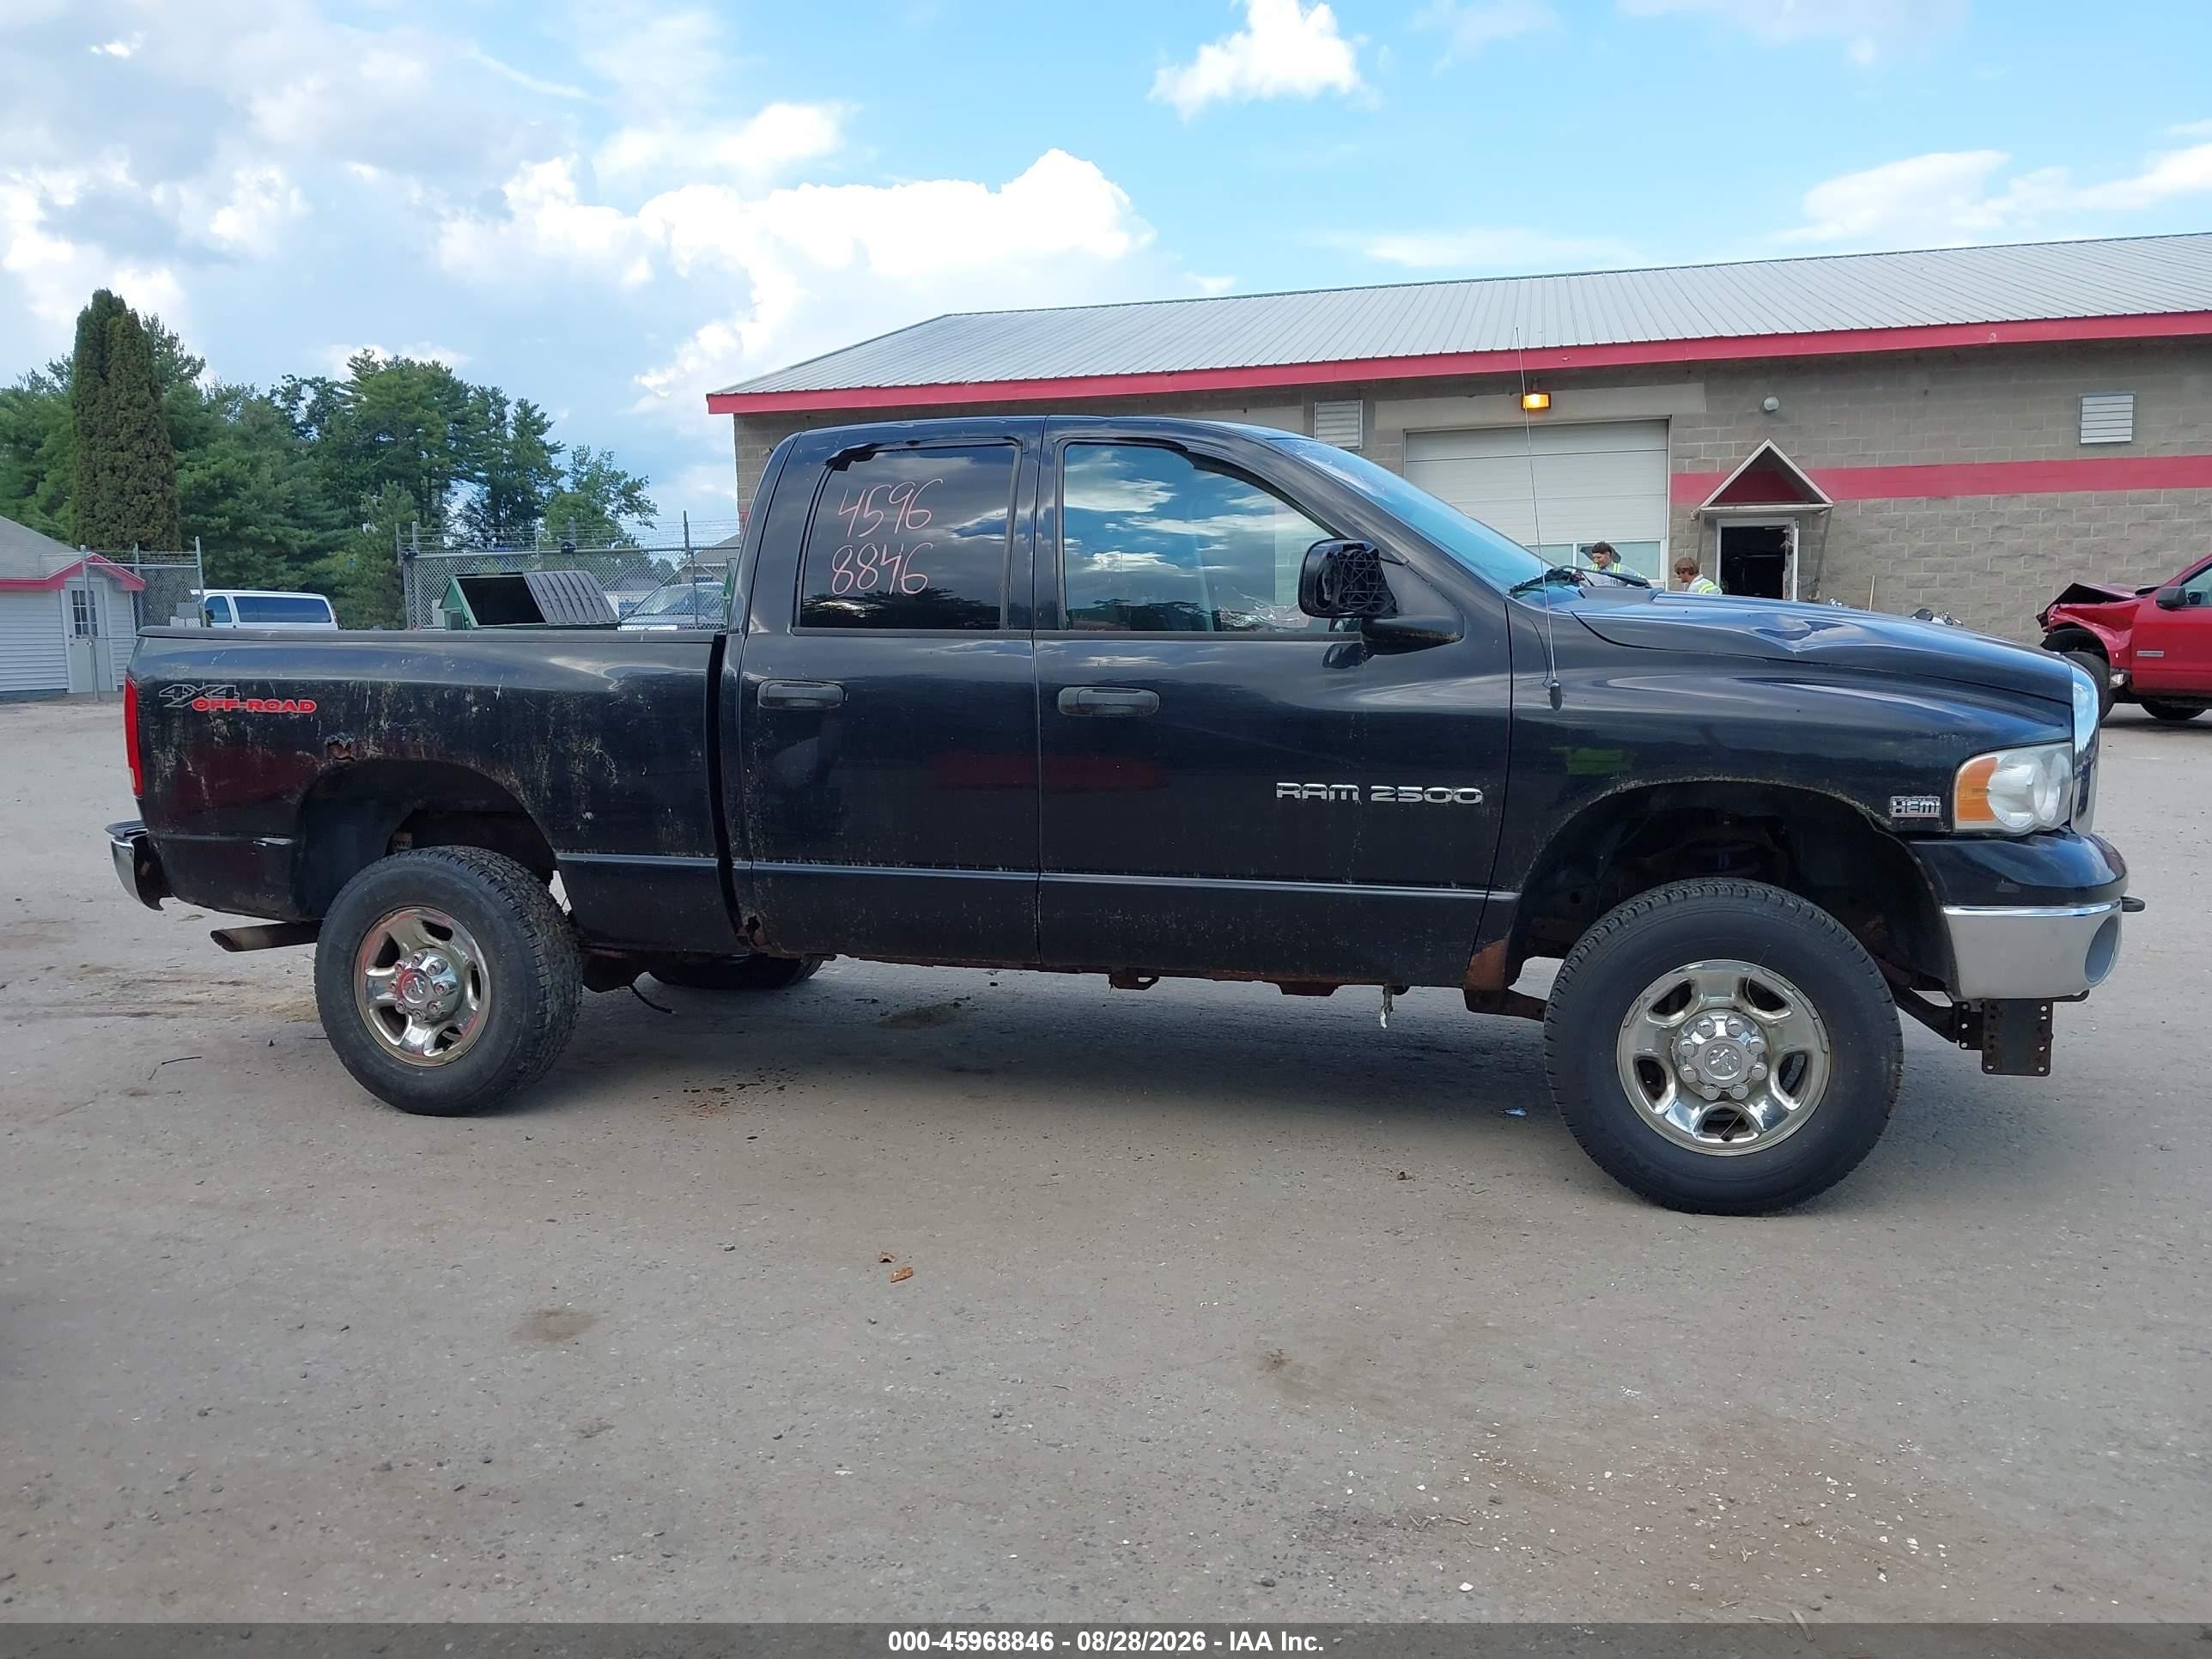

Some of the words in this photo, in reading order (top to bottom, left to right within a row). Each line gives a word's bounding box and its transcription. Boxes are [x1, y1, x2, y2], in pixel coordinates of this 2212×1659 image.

[838, 478, 944, 538] 4596
[831, 542, 934, 596] 8846
[191, 698, 318, 714] OFF-ROAD
[1276, 782, 1360, 801] RAM
[1370, 785, 1484, 805] 2500
[1892, 799, 1941, 815] HEMI
